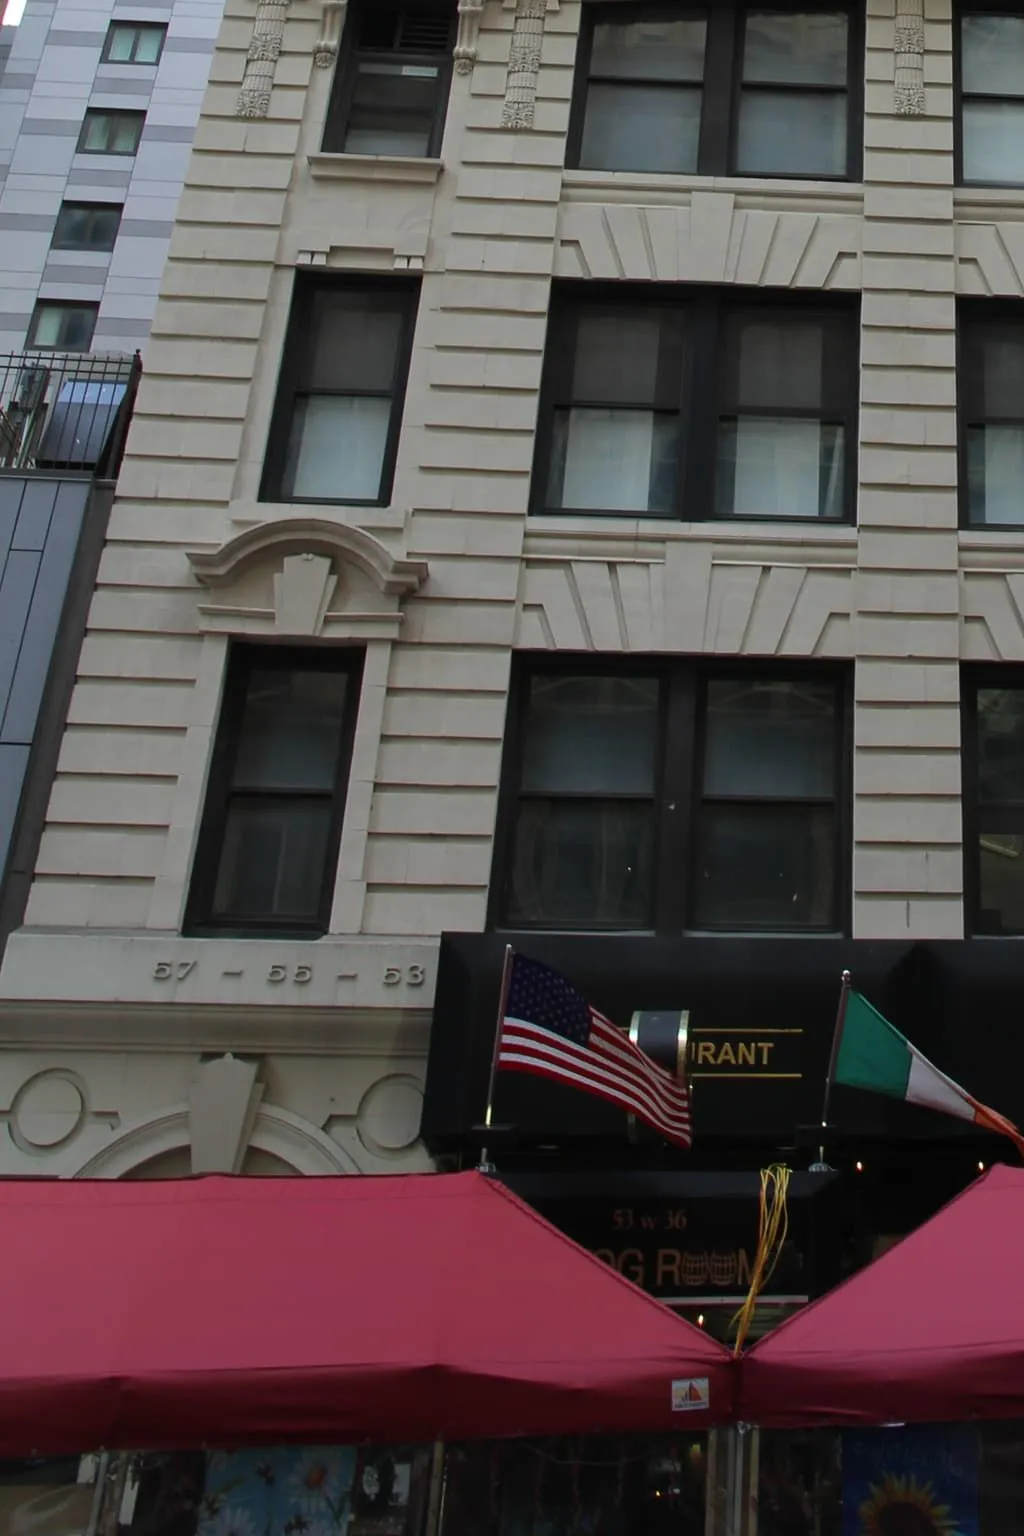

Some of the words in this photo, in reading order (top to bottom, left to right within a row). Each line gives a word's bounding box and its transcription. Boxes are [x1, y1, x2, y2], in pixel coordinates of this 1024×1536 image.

[152, 959, 198, 981] 57
[266, 963, 313, 984] 55
[381, 964, 425, 986] 53
[690, 1041, 776, 1066] RANT
[611, 1208, 634, 1231] 53
[664, 1208, 689, 1231] 36
